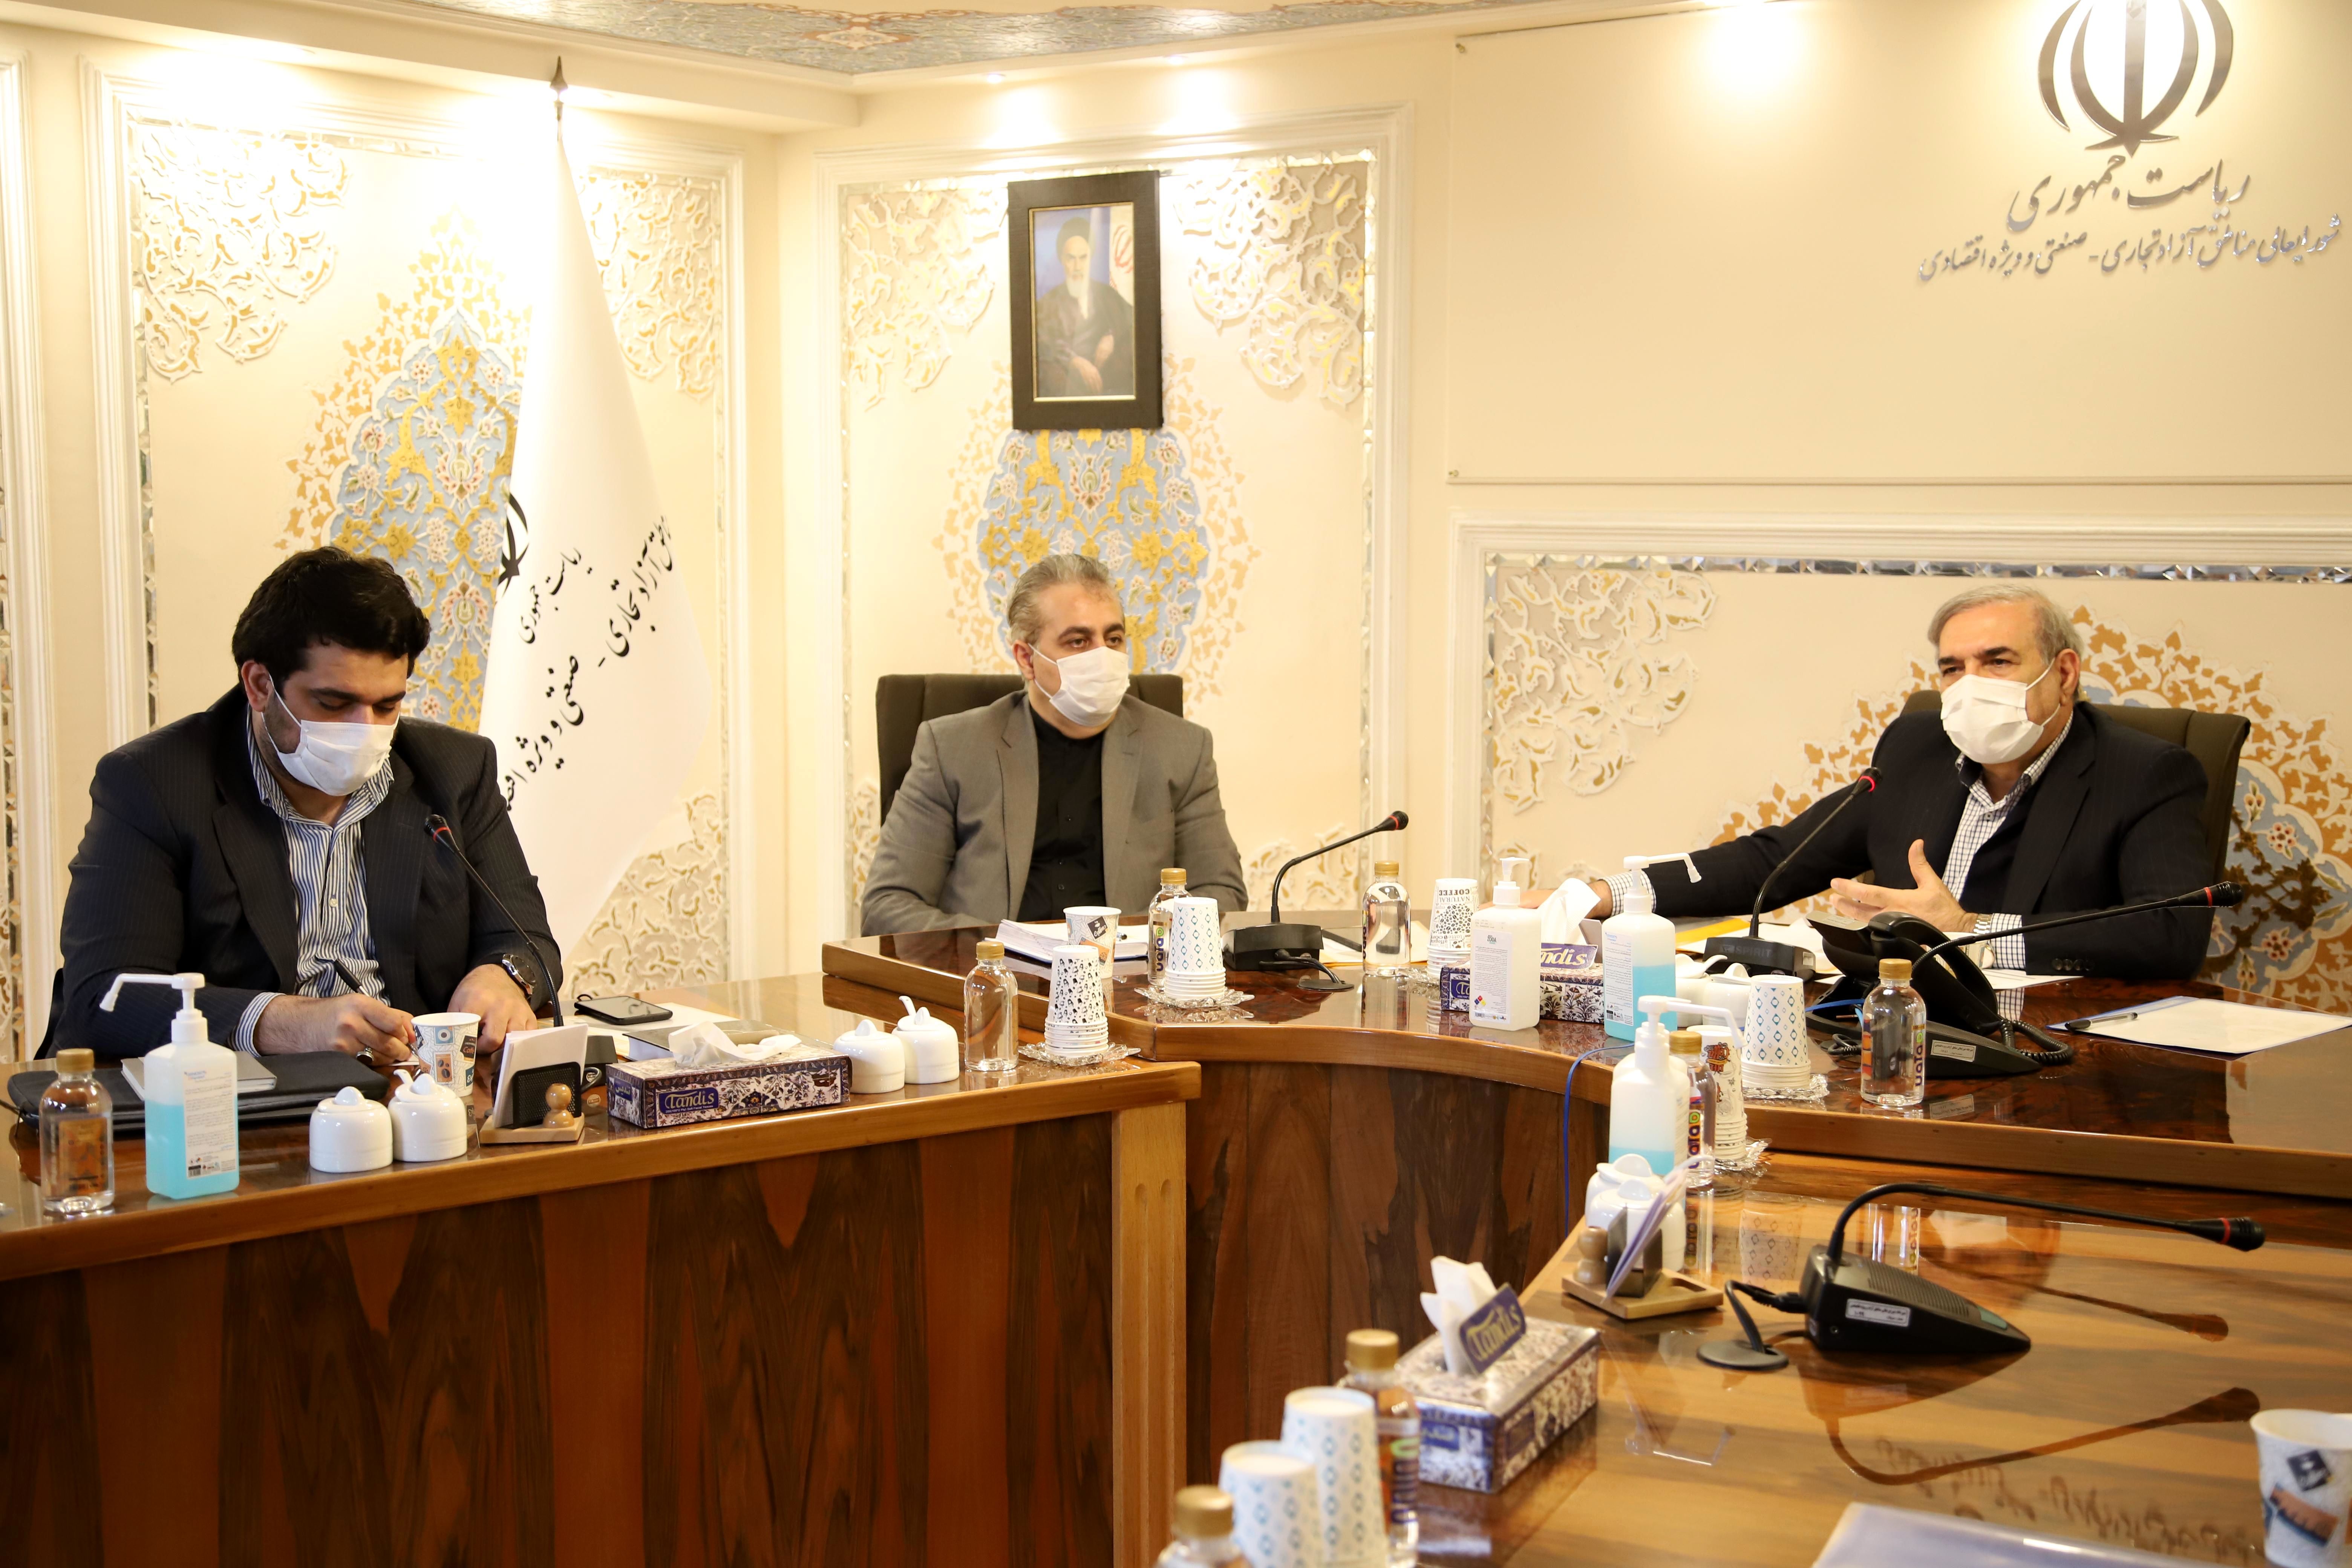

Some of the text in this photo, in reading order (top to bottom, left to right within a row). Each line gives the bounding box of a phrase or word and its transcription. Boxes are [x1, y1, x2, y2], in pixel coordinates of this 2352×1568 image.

[2006, 155, 2251, 232] ریاست جمهوری
[1919, 235, 1986, 281] اقتصادی
[1989, 239, 2023, 276] ویژه
[2023, 251, 2034, 266] و
[2035, 231, 2087, 274] صنعتی
[2102, 228, 2161, 273] تجاری
[2155, 225, 2206, 261] آزاد
[2197, 224, 2256, 268] مناطق
[631, 539, 661, 602] آزاد
[518, 547, 593, 644] ریاست جمهوری
[605, 579, 655, 657] تجاری
[545, 655, 584, 726] صنعتی
[550, 720, 562, 736] و
[516, 735, 564, 773] ویژه
[1093, 925, 1107, 937] Coffee
[1541, 948, 1587, 965] ndis
[665, 1091, 714, 1109] Tandis
[1466, 1304, 1522, 1362] Tandis
